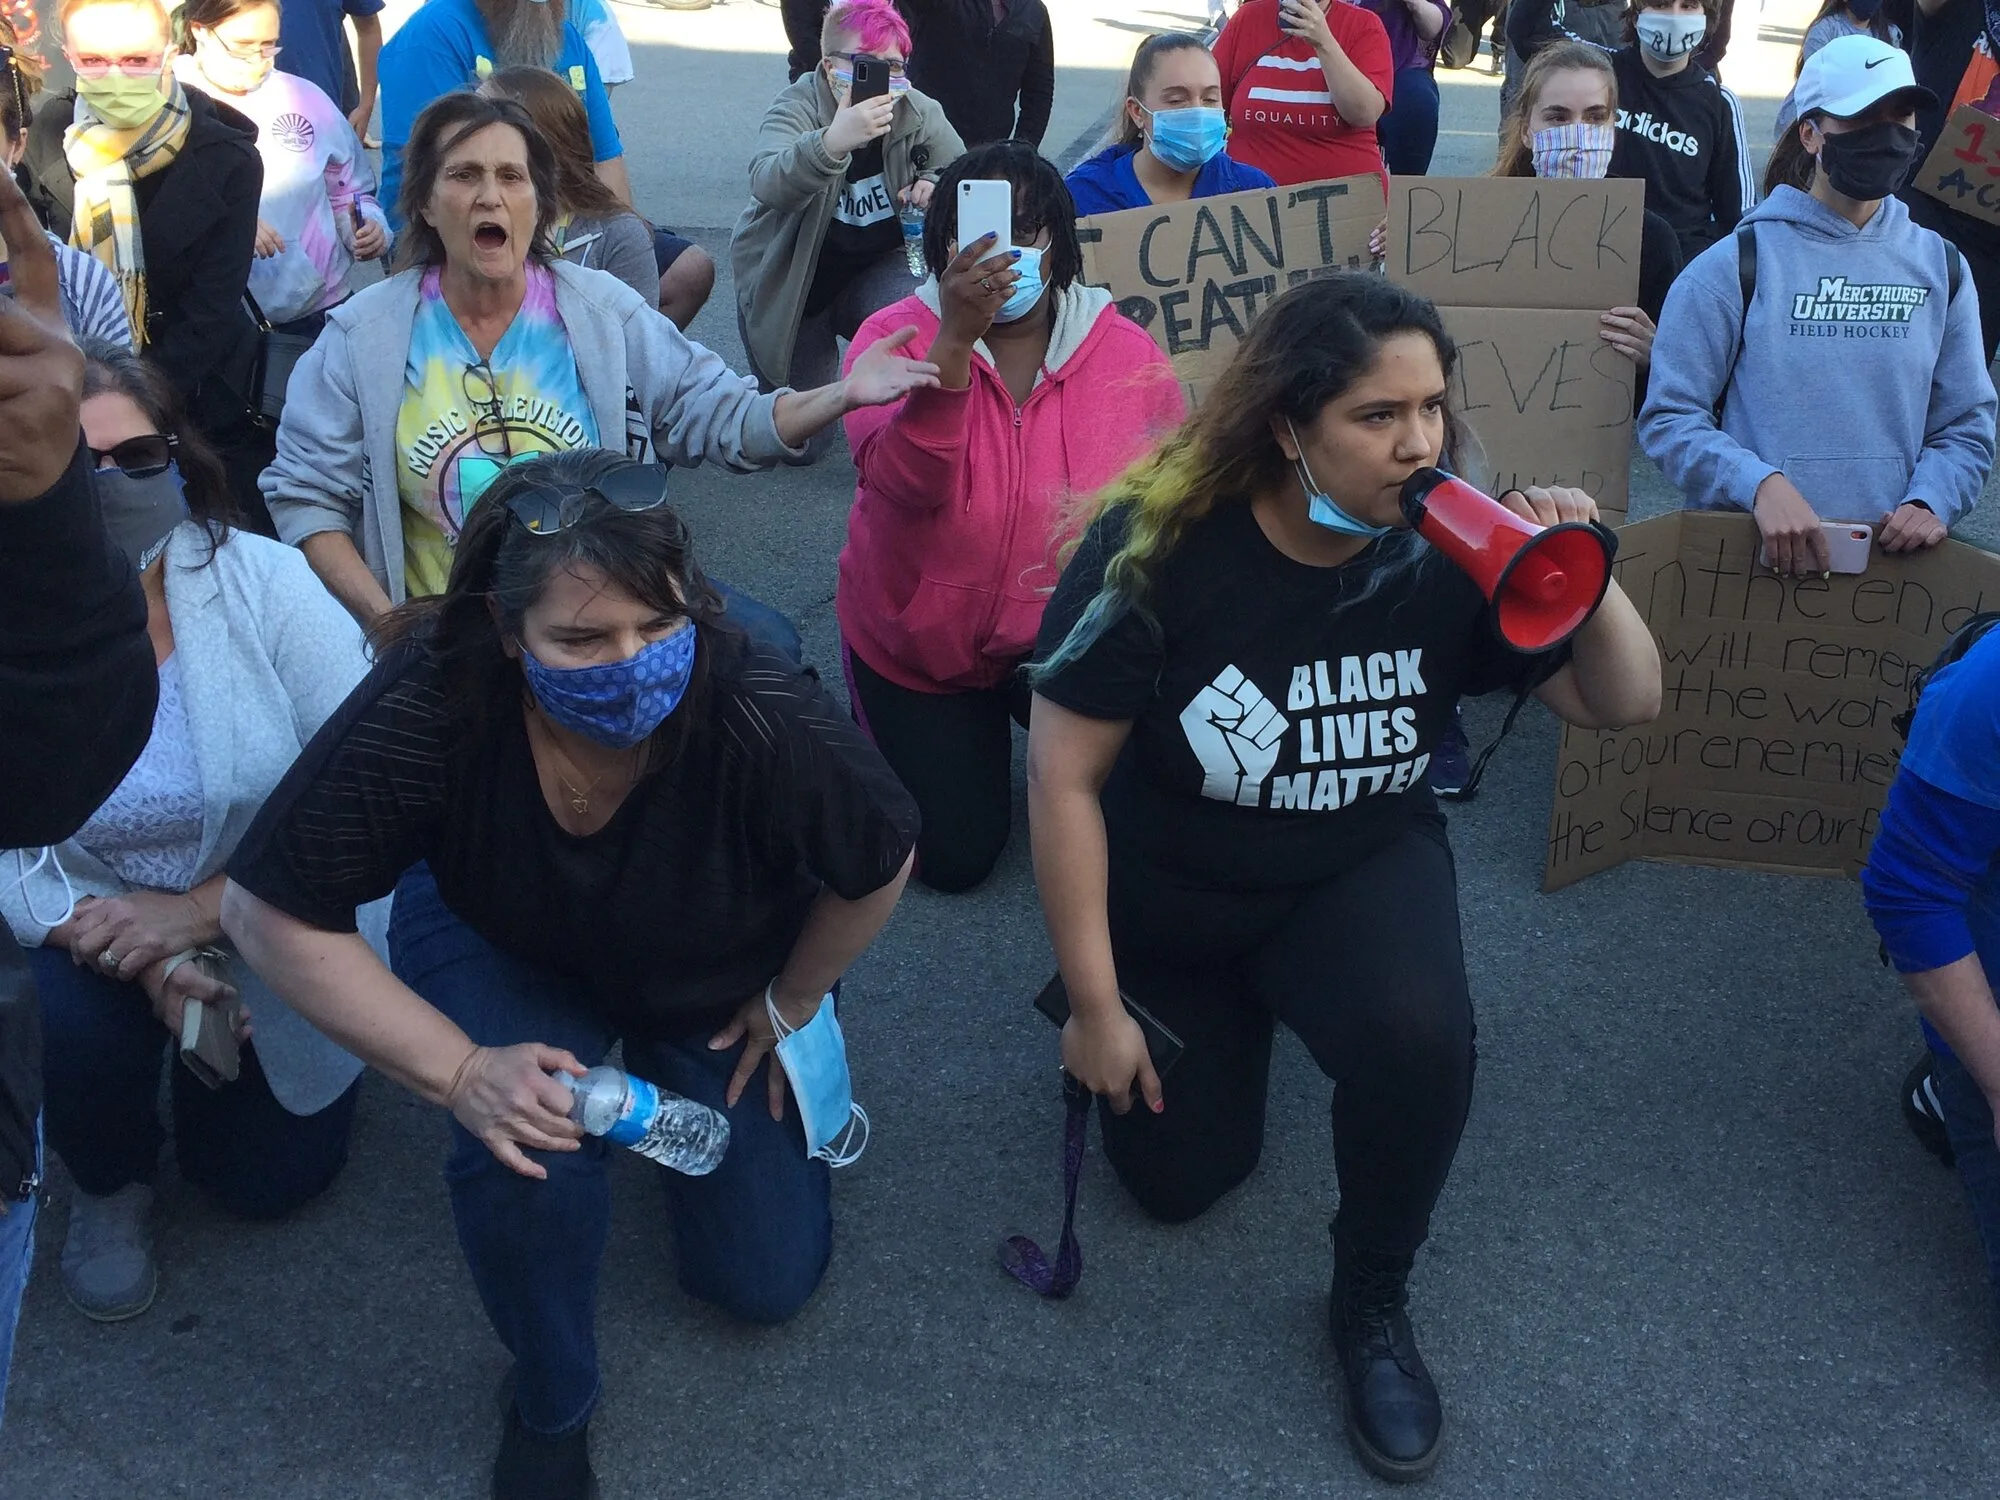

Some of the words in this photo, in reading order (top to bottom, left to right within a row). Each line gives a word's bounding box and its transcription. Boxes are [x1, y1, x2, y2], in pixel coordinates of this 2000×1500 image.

[1244, 109, 1341, 127] EQUALITY
[1614, 108, 1699, 157] adidas
[1138, 184, 1348, 288] CAN'T
[1406, 186, 1628, 276] BLACK
[1792, 294, 1914, 321] UNIVERSITY
[1816, 277, 1929, 305] MERCYHURST
[1789, 323, 1838, 337] FIELD
[1843, 325, 1910, 339] HOCKEY
[1455, 340, 1633, 430] IVES
[408, 407, 468, 479] MUSIC
[1698, 538, 1830, 624] the
[1287, 648, 1428, 711] BLACK
[1659, 631, 1752, 671] will
[1666, 669, 1769, 720] the
[1783, 693, 1894, 728] wor
[1300, 706, 1418, 764] LIVES
[1700, 735, 1899, 786] enemie
[1269, 752, 1431, 811] MATTER
[1550, 811, 1604, 868] the
